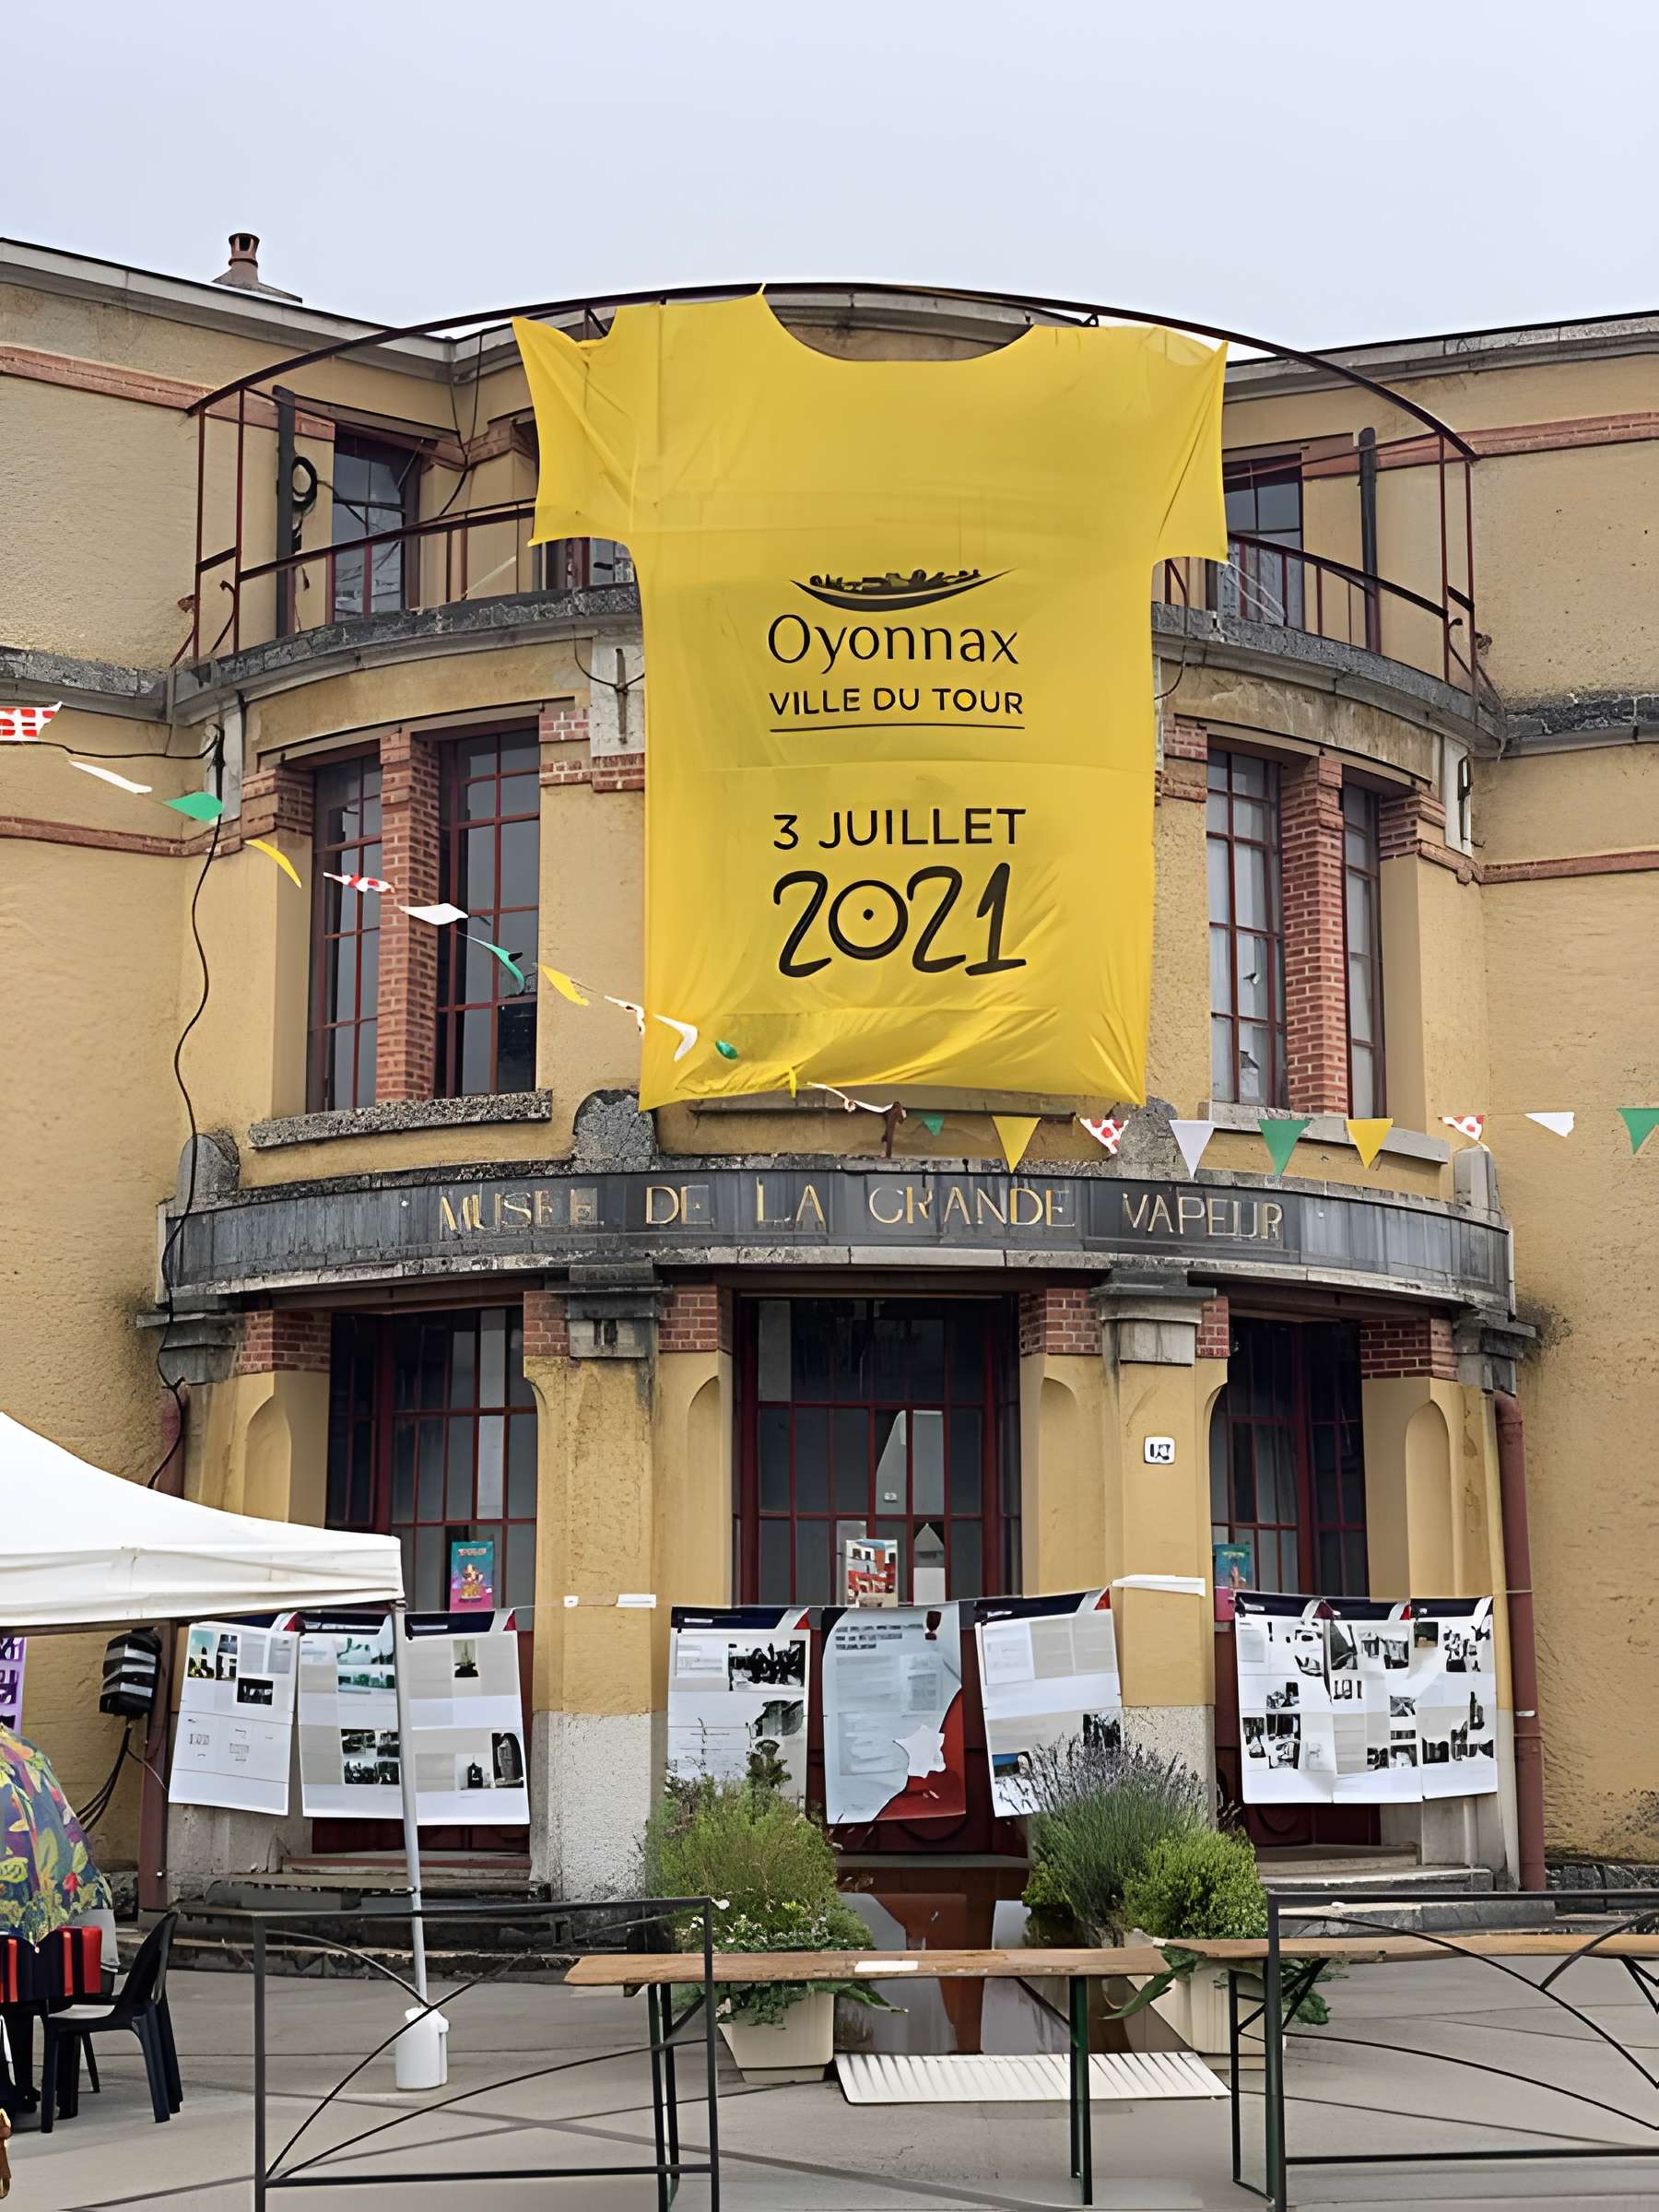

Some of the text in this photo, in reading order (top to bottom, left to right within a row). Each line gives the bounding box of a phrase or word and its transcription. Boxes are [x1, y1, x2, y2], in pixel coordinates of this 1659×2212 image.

[767, 613, 1020, 675] Oyonnax
[769, 687, 1023, 716] VILLE DU TOUR
[772, 807, 1028, 851] 3 JUILLET
[772, 862, 1028, 979] 2021
[644, 1185, 713, 1225] DE
[756, 1182, 827, 1225] LA
[868, 1186, 1076, 1228] GRANDE
[1122, 1193, 1284, 1240] VAPEUR
